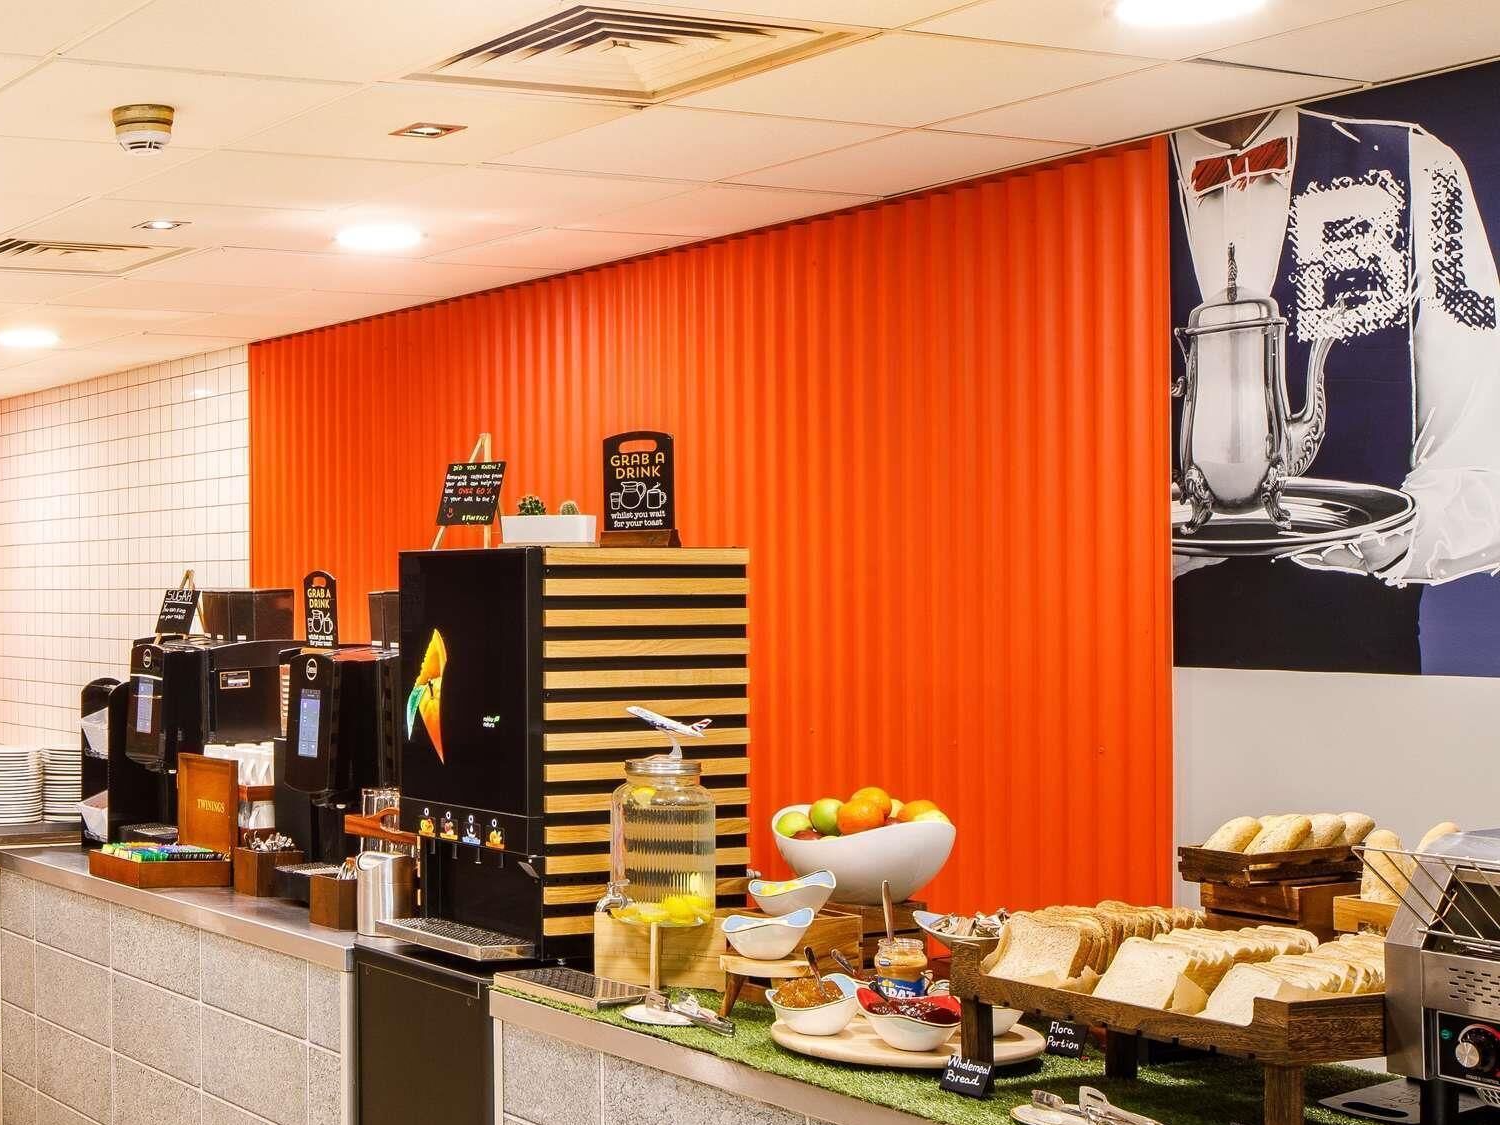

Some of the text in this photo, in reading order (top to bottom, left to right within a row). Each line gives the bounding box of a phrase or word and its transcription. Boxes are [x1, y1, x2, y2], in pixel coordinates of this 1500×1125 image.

[610, 452, 664, 466] GRAB A
[616, 465, 660, 479] DRINK
[611, 511, 633, 519] whilst
[626, 520, 644, 528] your
[165, 590, 192, 601] SUGAR
[308, 588, 331, 598] GRAB A
[309, 599, 330, 608] DRINK
[197, 799, 225, 813] TWININGS
[1050, 1021, 1074, 1036] Flora
[1047, 1036, 1079, 1050] Portion
[947, 1056, 991, 1075] Wholemeal
[946, 1070, 980, 1086] Bread
